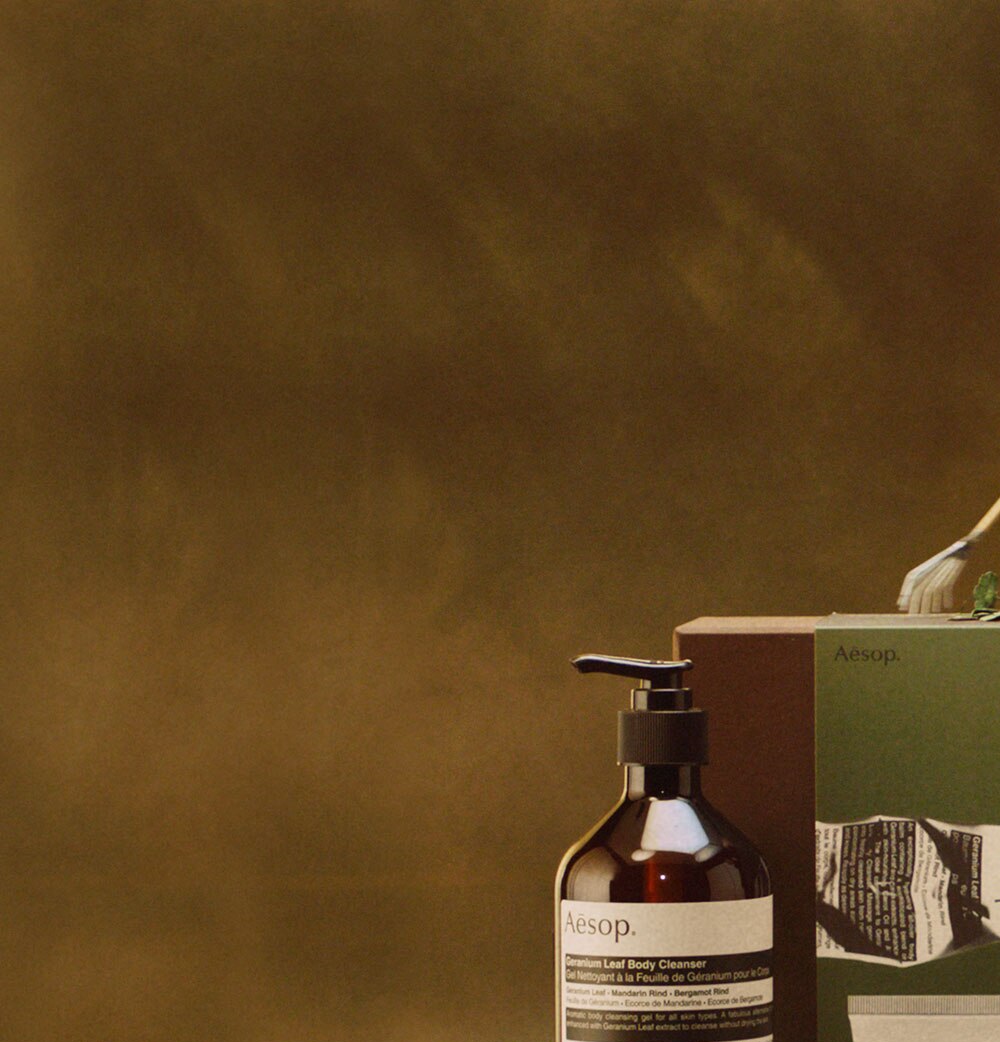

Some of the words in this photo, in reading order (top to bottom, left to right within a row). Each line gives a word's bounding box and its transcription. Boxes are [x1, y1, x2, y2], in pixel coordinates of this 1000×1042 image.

[971, 836, 981, 879] Geranium
[971, 880, 980, 899] Leaf
[566, 956, 602, 968] Geranium
[603, 959, 626, 969] Leaf
[628, 959, 656, 972] Body
[659, 959, 707, 969] Cleanser
[577, 970, 615, 983] Nettoyant
[617, 971, 624, 982] à
[625, 972, 634, 982] la
[636, 972, 669, 982] Feuille
[672, 973, 685, 982] de
[687, 971, 732, 982] Géranium
[733, 970, 749, 981] pour
[611, 990, 647, 998] Mandarin
[674, 989, 712, 998] Bergamot
[713, 987, 730, 996] Rind
[663, 999, 702, 1007] Mandarine
[707, 997, 730, 1006] Ecorce
[731, 996, 739, 1004] de
[604, 1013, 638, 1022] cleansing
[641, 1014, 653, 1022] gel
[655, 1013, 665, 1021] for
[669, 1013, 677, 1021] all
[681, 1012, 696, 1021] skin
[603, 1022, 636, 1031] Geranium
[638, 1023, 655, 1031] Leaf
[656, 1023, 680, 1031] extract
